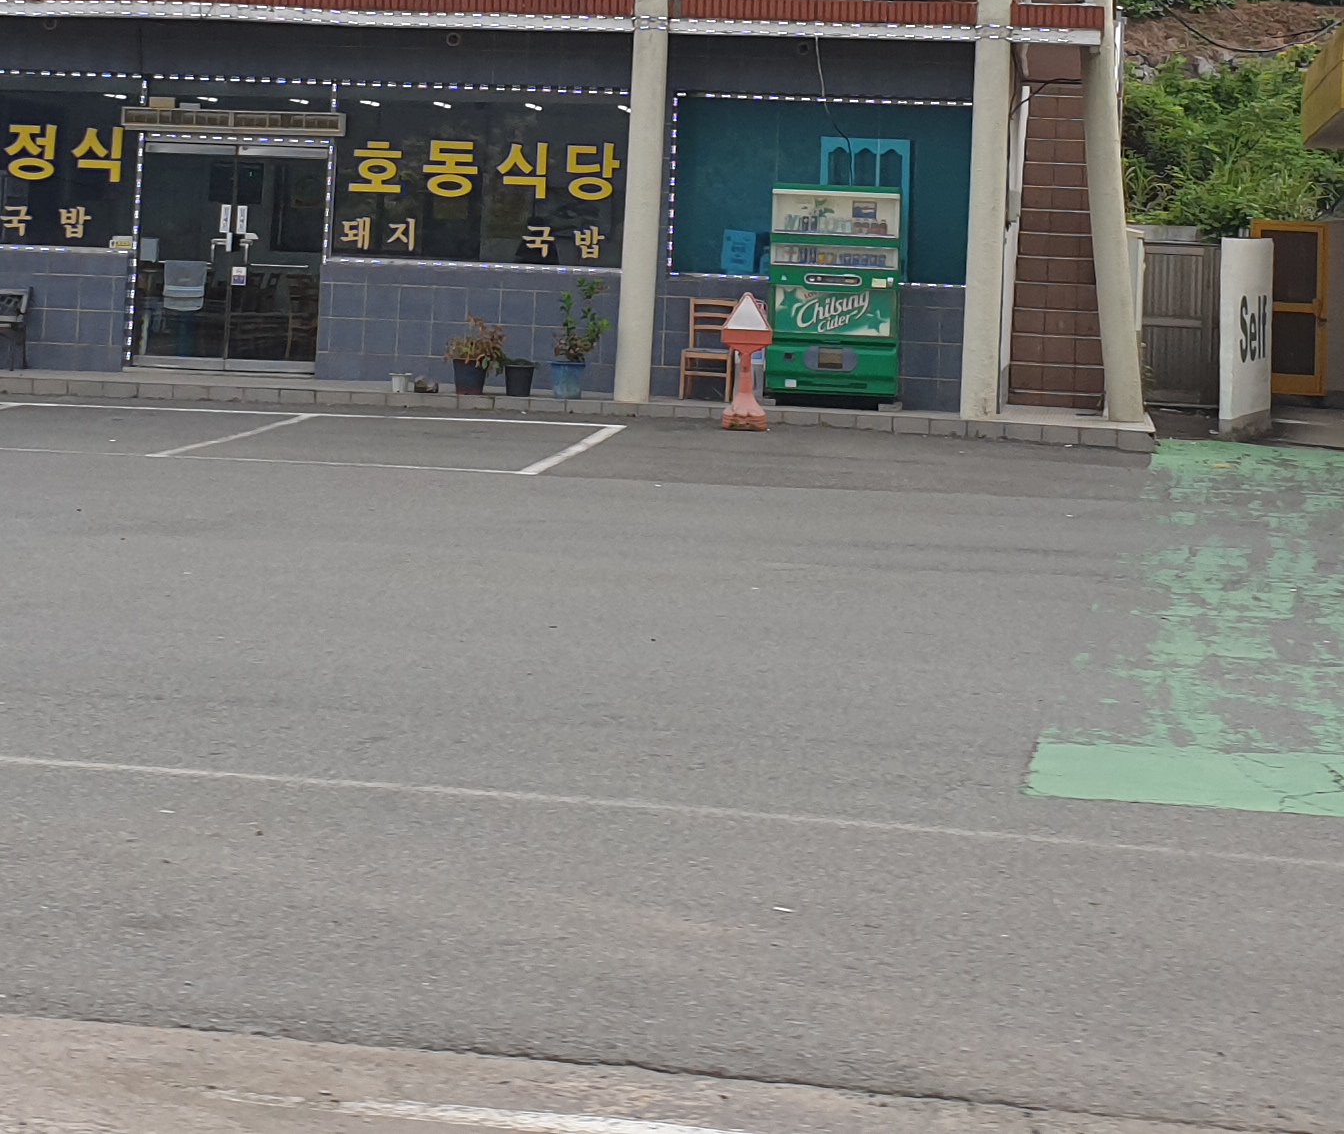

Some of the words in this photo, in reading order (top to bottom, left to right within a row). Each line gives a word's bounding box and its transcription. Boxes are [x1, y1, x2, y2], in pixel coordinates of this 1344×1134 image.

[348, 139, 621, 201] 호동식당
[796, 290, 870, 329] Chilsung
[1239, 294, 1267, 363] Self
